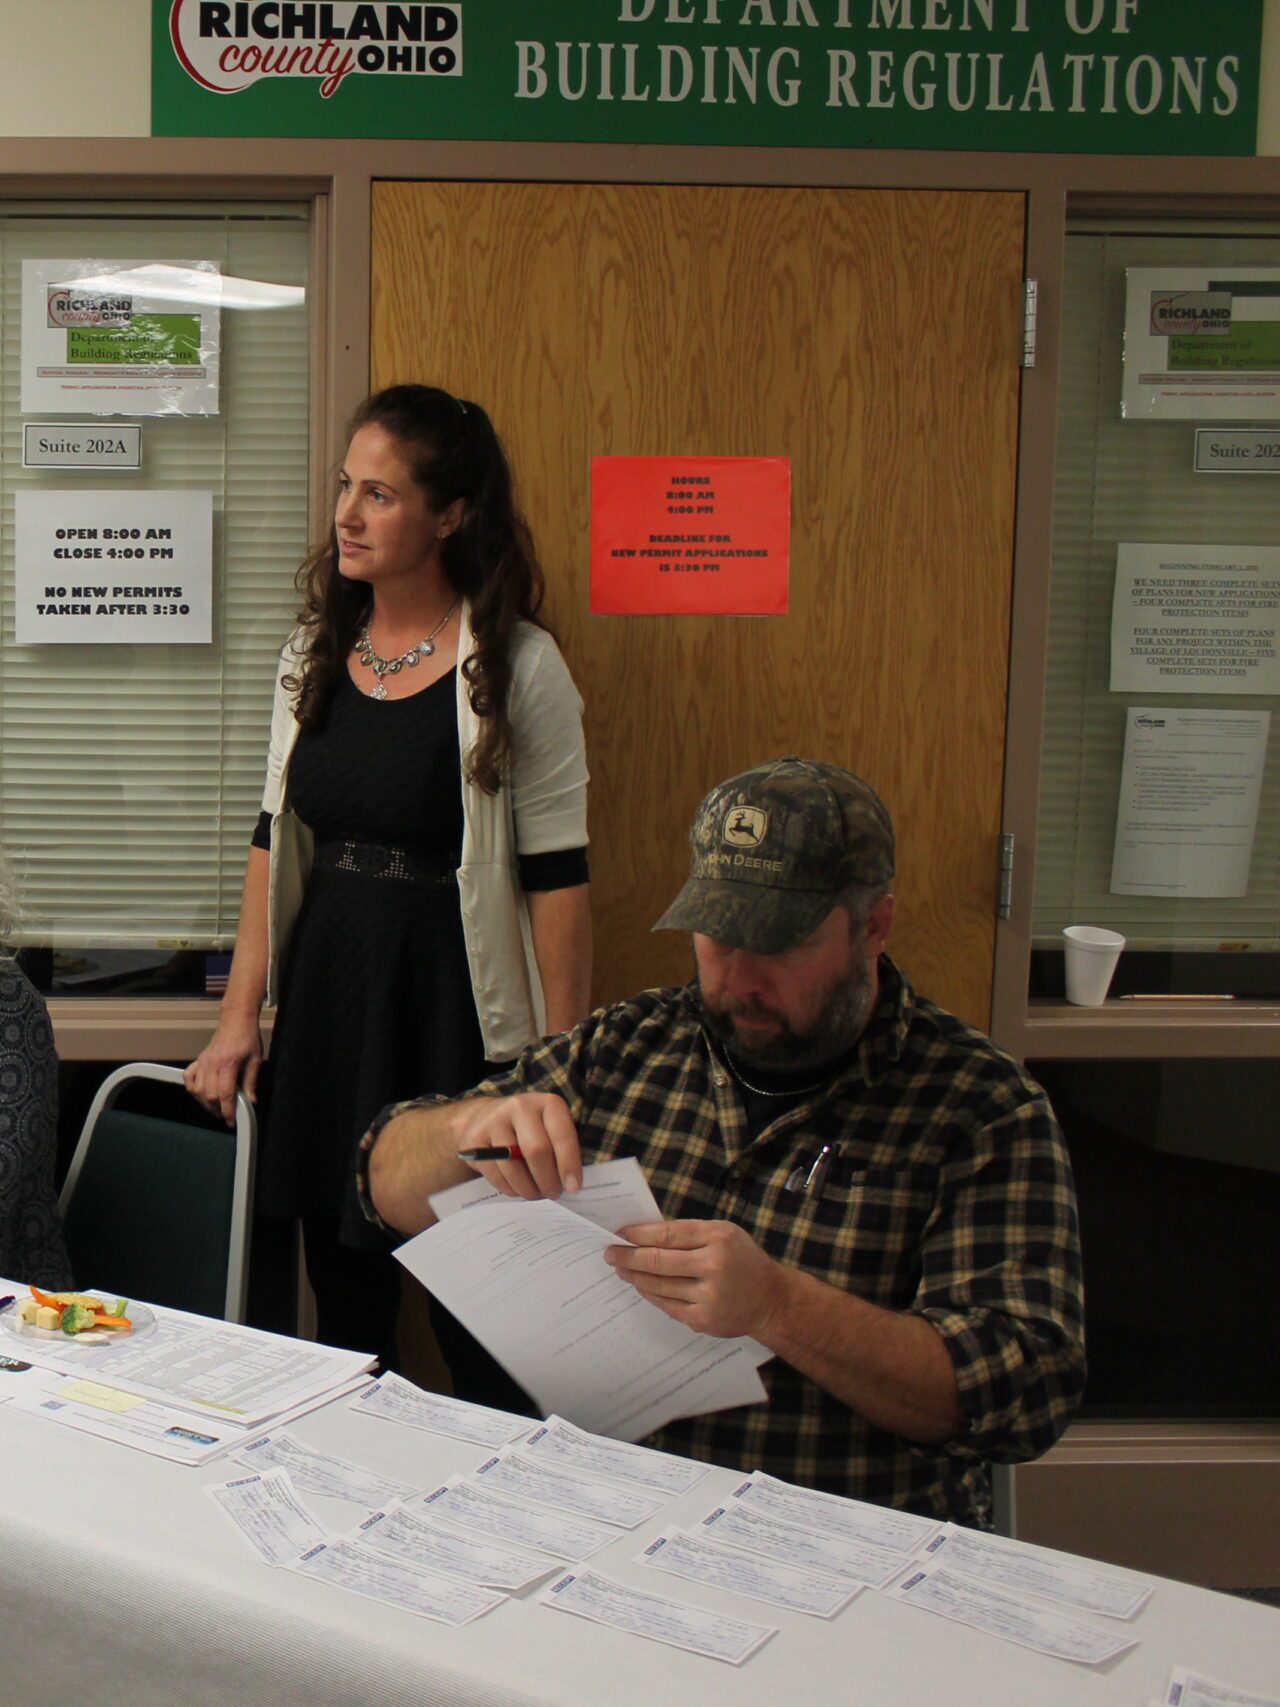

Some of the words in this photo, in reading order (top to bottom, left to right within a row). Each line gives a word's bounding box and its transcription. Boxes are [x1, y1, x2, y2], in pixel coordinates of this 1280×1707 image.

[199, 2, 458, 42] RICHLAND
[219, 34, 356, 97] county
[357, 44, 456, 73] OHIO
[514, 40, 801, 107] BUILDING
[825, 49, 1239, 115] REGULATIONS
[1159, 308, 1231, 319] RICHLAND
[1202, 320, 1230, 328] OHIO
[71, 348, 120, 361] Building
[39, 438, 81, 453] Suite
[86, 439, 127, 453] 202A
[1210, 444, 1250, 458] Suite
[671, 477, 711, 485] HOURS
[696, 491, 715, 499] AM
[697, 506, 714, 514] PM
[56, 529, 98, 539] OPEN
[103, 529, 140, 539] 8:00
[145, 529, 171, 539] AM
[649, 535, 706, 543] DEADLINE
[709, 535, 731, 543] FOR
[54, 548, 102, 559] CLOSE
[107, 548, 145, 559] 4:00
[149, 548, 173, 559] PM
[611, 549, 636, 557] NEW
[640, 549, 682, 557] PERMIT
[685, 549, 768, 557] APPLICATIONS
[659, 564, 670, 572] IS
[703, 564, 720, 572] PM
[1134, 579, 1146, 587] WE
[1150, 579, 1175, 587] NEED
[1179, 579, 1207, 587] THREE
[1210, 580, 1259, 588] COMPLETE
[45, 587, 67, 598] NO
[72, 587, 108, 598] NEW
[112, 587, 183, 598] PERMITS
[1146, 589, 1174, 597] PLANS
[1176, 589, 1193, 597] FOR
[1195, 590, 1216, 598] NEW
[1140, 599, 1166, 607] FOUR
[1166, 599, 1212, 608] COMPLETE
[37, 604, 91, 615] TAKEN
[96, 604, 147, 615] AFTER
[152, 604, 190, 615] 3:30
[1161, 609, 1220, 617] PROTECTION
[1222, 609, 1249, 618] ITEMS
[1134, 628, 1158, 636] FOUR
[1160, 628, 1209, 637] COMPLETE
[1210, 629, 1231, 637] SETS
[1247, 630, 1275, 638] PLANS
[1136, 638, 1154, 646] FOR
[1156, 638, 1174, 646] ANY
[1176, 638, 1214, 647] PROJECT
[1130, 647, 1168, 655] VILLAGE
[1147, 657, 1195, 666] COMPLETE
[1240, 659, 1259, 667] FIRE
[1160, 667, 1218, 675] PROTECTION
[1220, 668, 1246, 676] ITEMS
[734, 854, 784, 872] DEERE
